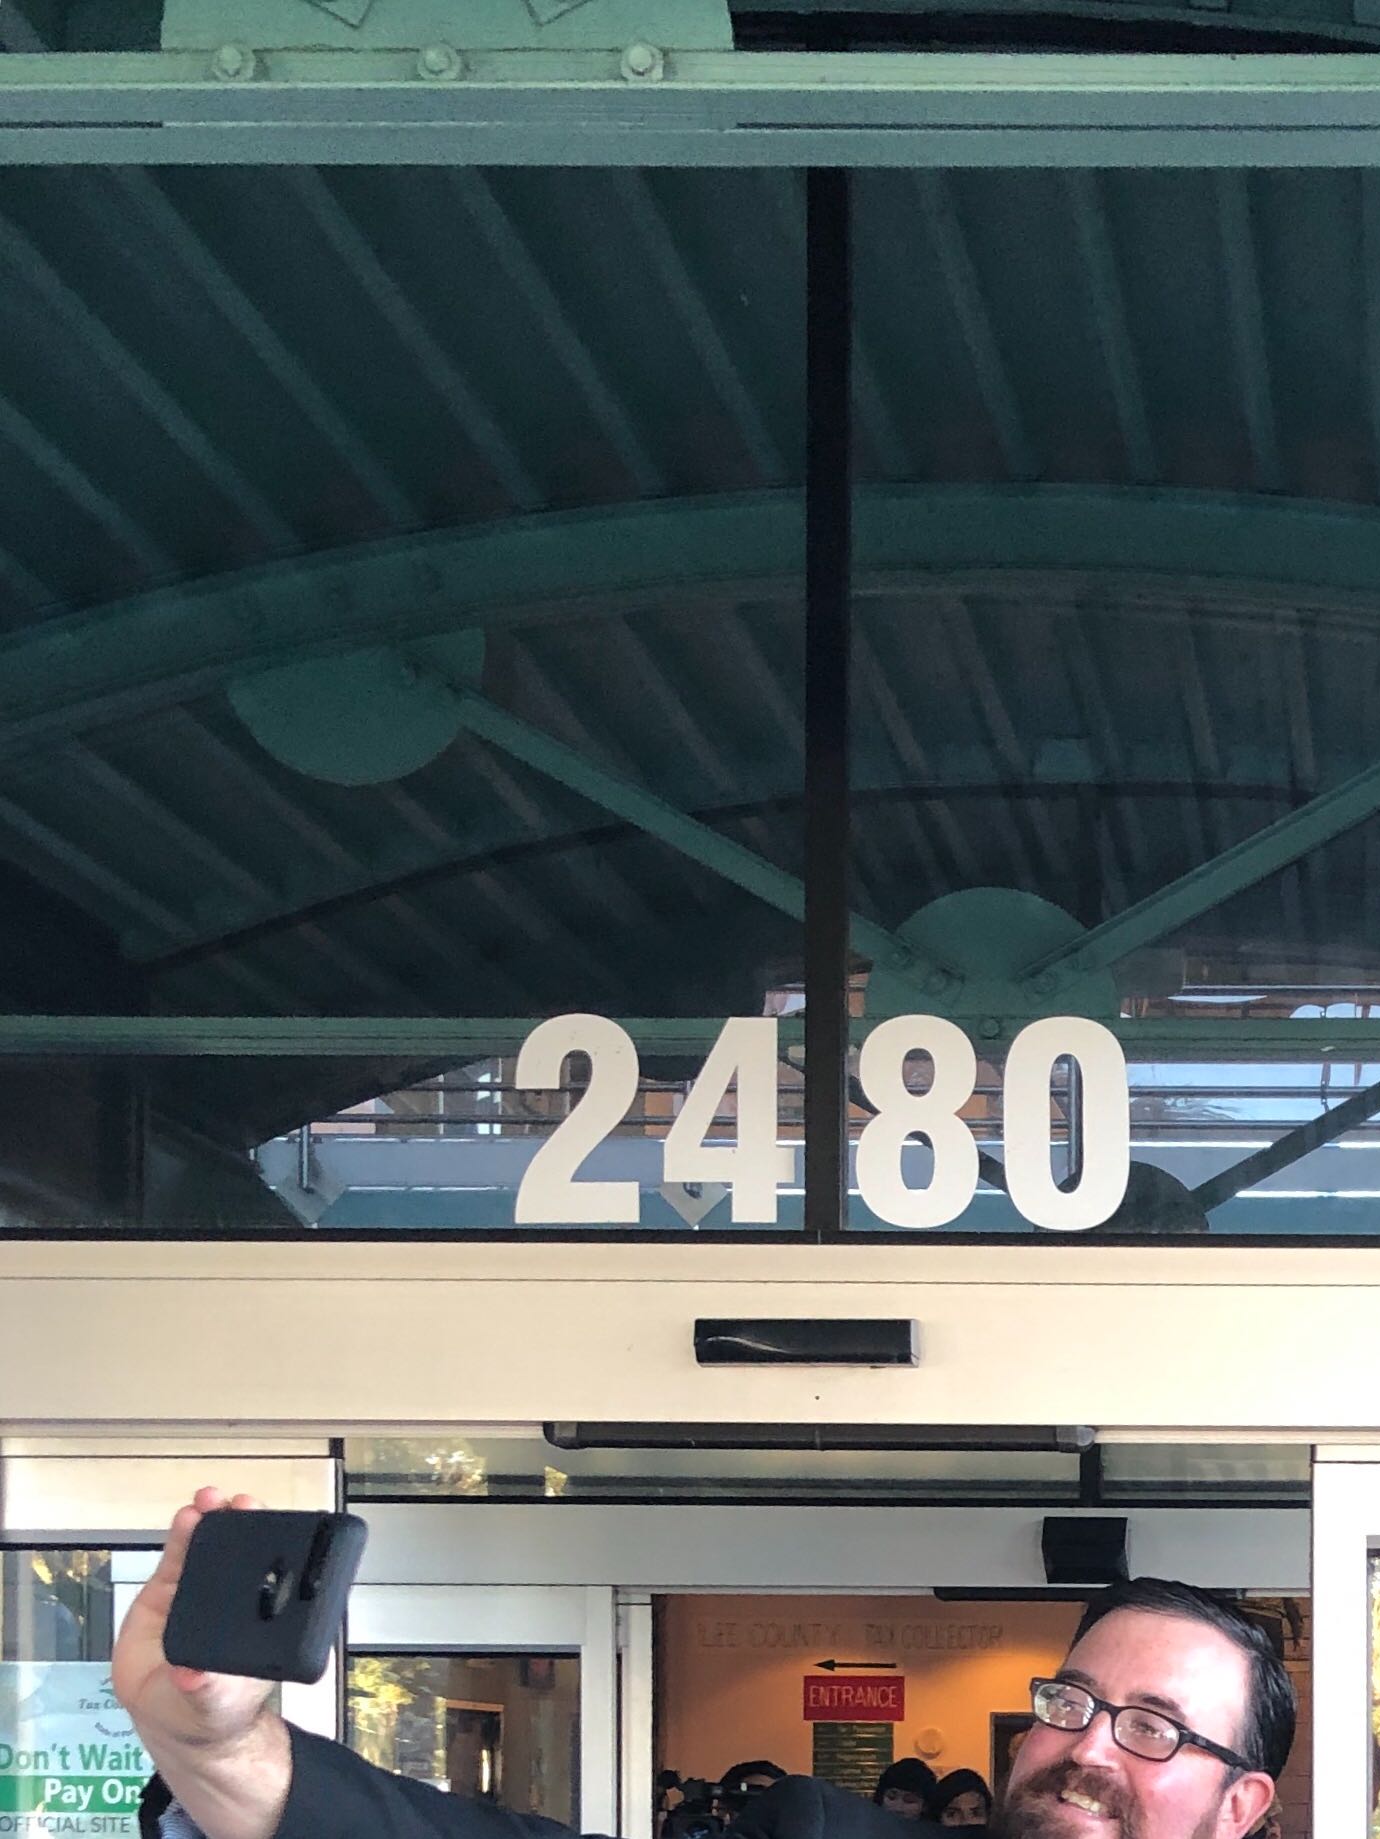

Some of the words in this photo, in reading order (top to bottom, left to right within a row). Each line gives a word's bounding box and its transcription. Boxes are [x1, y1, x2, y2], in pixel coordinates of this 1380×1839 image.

[514, 1012, 1130, 1231] 2480
[808, 1685, 898, 1708] ENTRANCE
[0, 1743, 70, 1771] Don't
[78, 1743, 144, 1771] Wait
[44, 1778, 94, 1810] Pay
[90, 1816, 131, 1833] SITE
